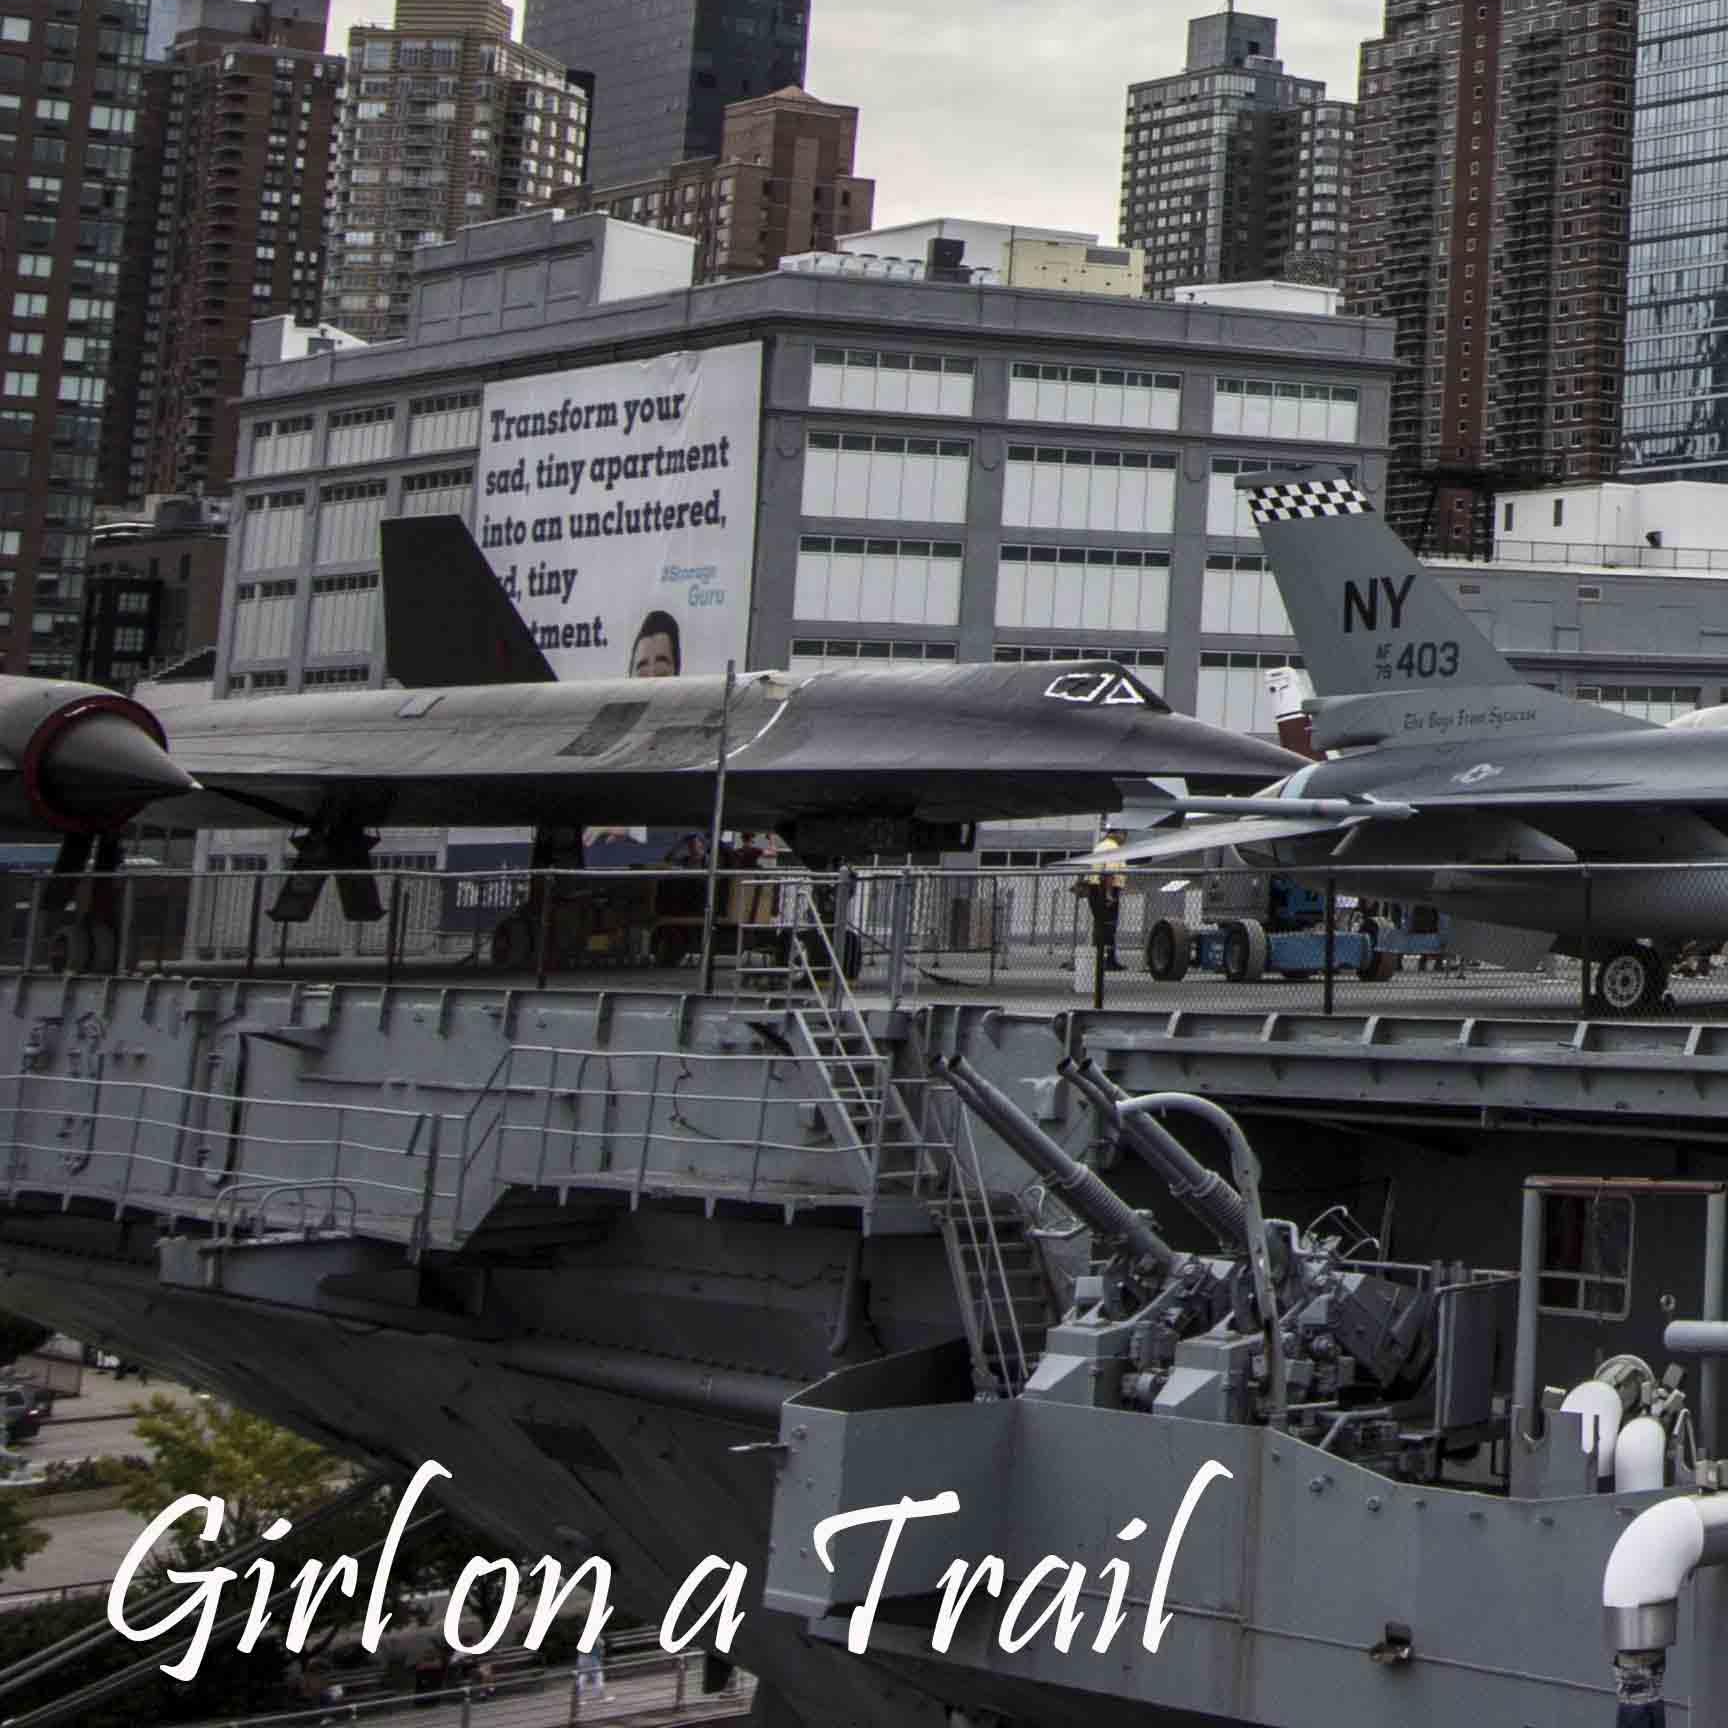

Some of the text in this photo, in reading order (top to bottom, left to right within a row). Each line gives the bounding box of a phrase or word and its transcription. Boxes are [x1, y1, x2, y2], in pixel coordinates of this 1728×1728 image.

[489, 392, 686, 443] Transform your
[485, 435, 730, 497] sad, tiny apartment
[481, 489, 727, 549] into an uncluttered,
[527, 562, 579, 604] tiny
[687, 584, 726, 607] Guru
[1344, 574, 1416, 633] NY
[1375, 643, 1393, 659] AF
[1396, 640, 1460, 679] 403
